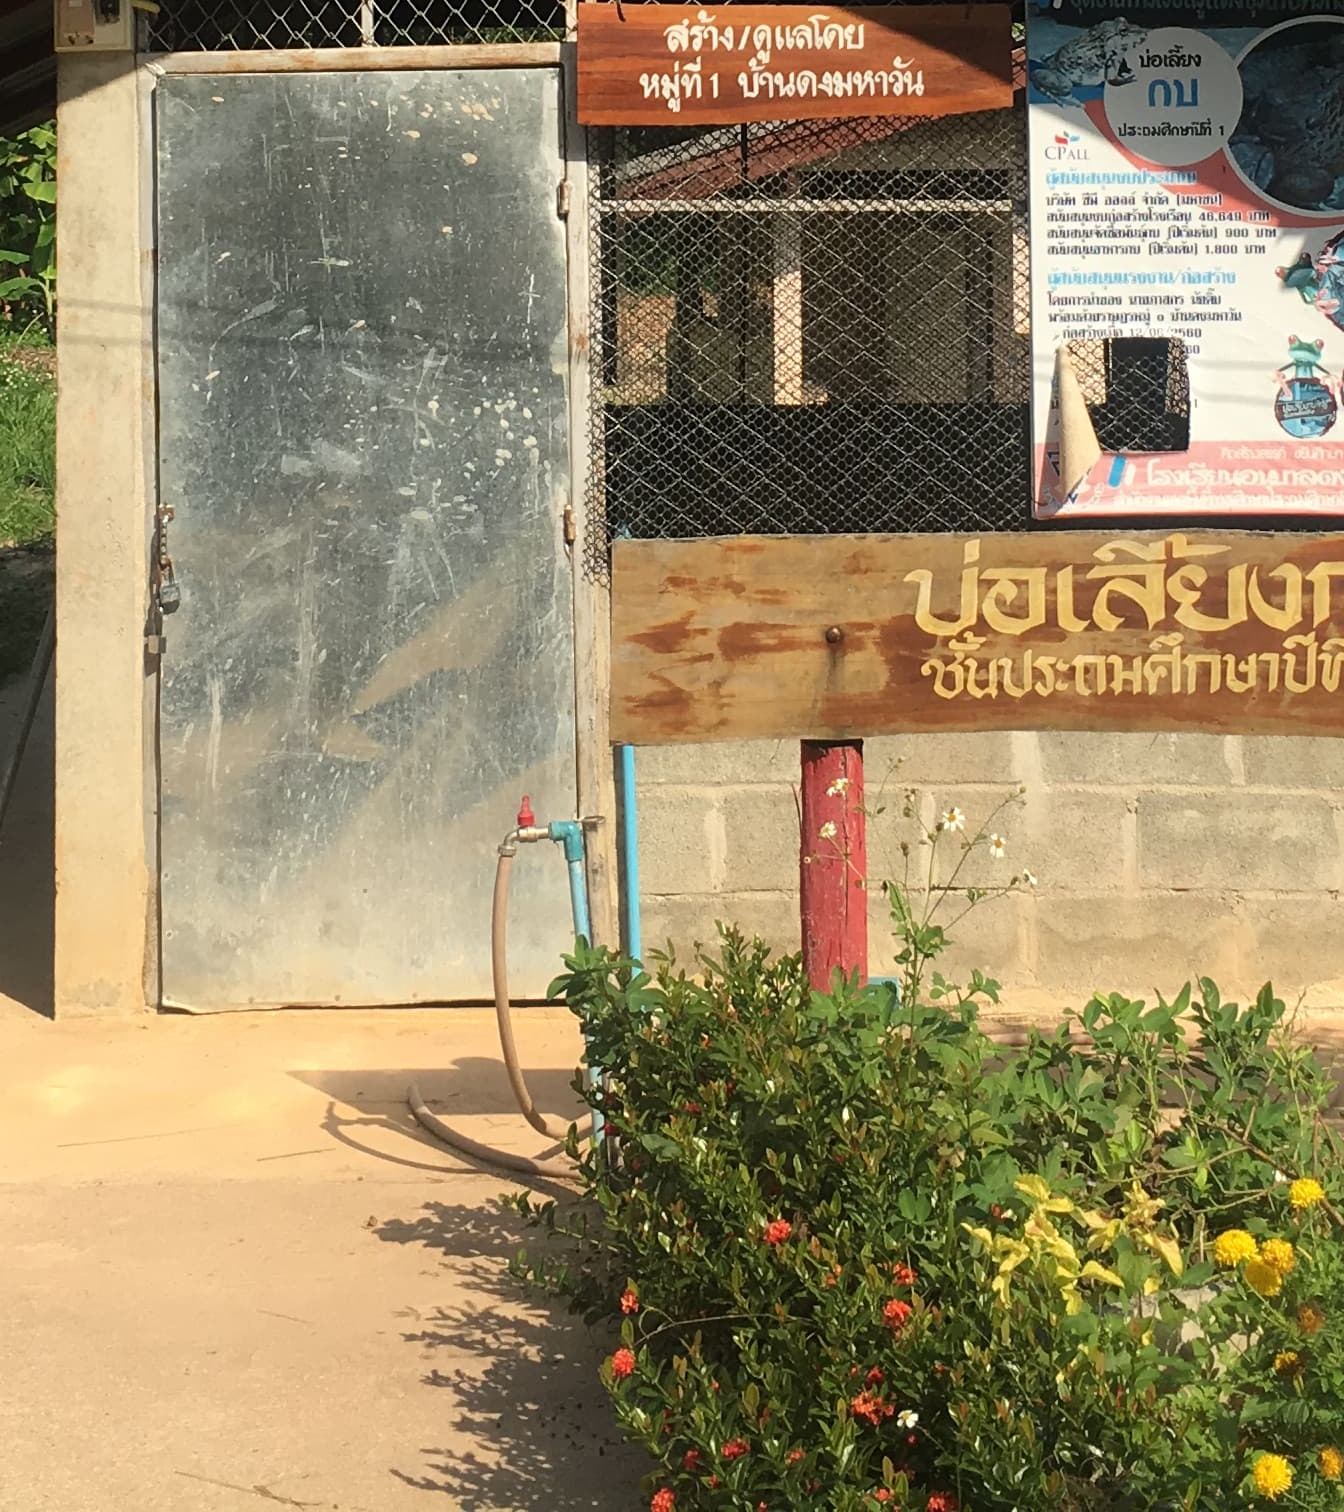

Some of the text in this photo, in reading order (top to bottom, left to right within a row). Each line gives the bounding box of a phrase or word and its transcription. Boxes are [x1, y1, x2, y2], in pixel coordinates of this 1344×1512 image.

[663, 9, 865, 64] สร้าง/ดูแลโดย
[1138, 44, 1202, 68] บ่อเลี้ยง
[737, 55, 925, 98] บ้านดงมหาวัน
[1147, 78, 1199, 107] กบ
[1118, 118, 1225, 137] ประถมศึกษาปีที่ 1
